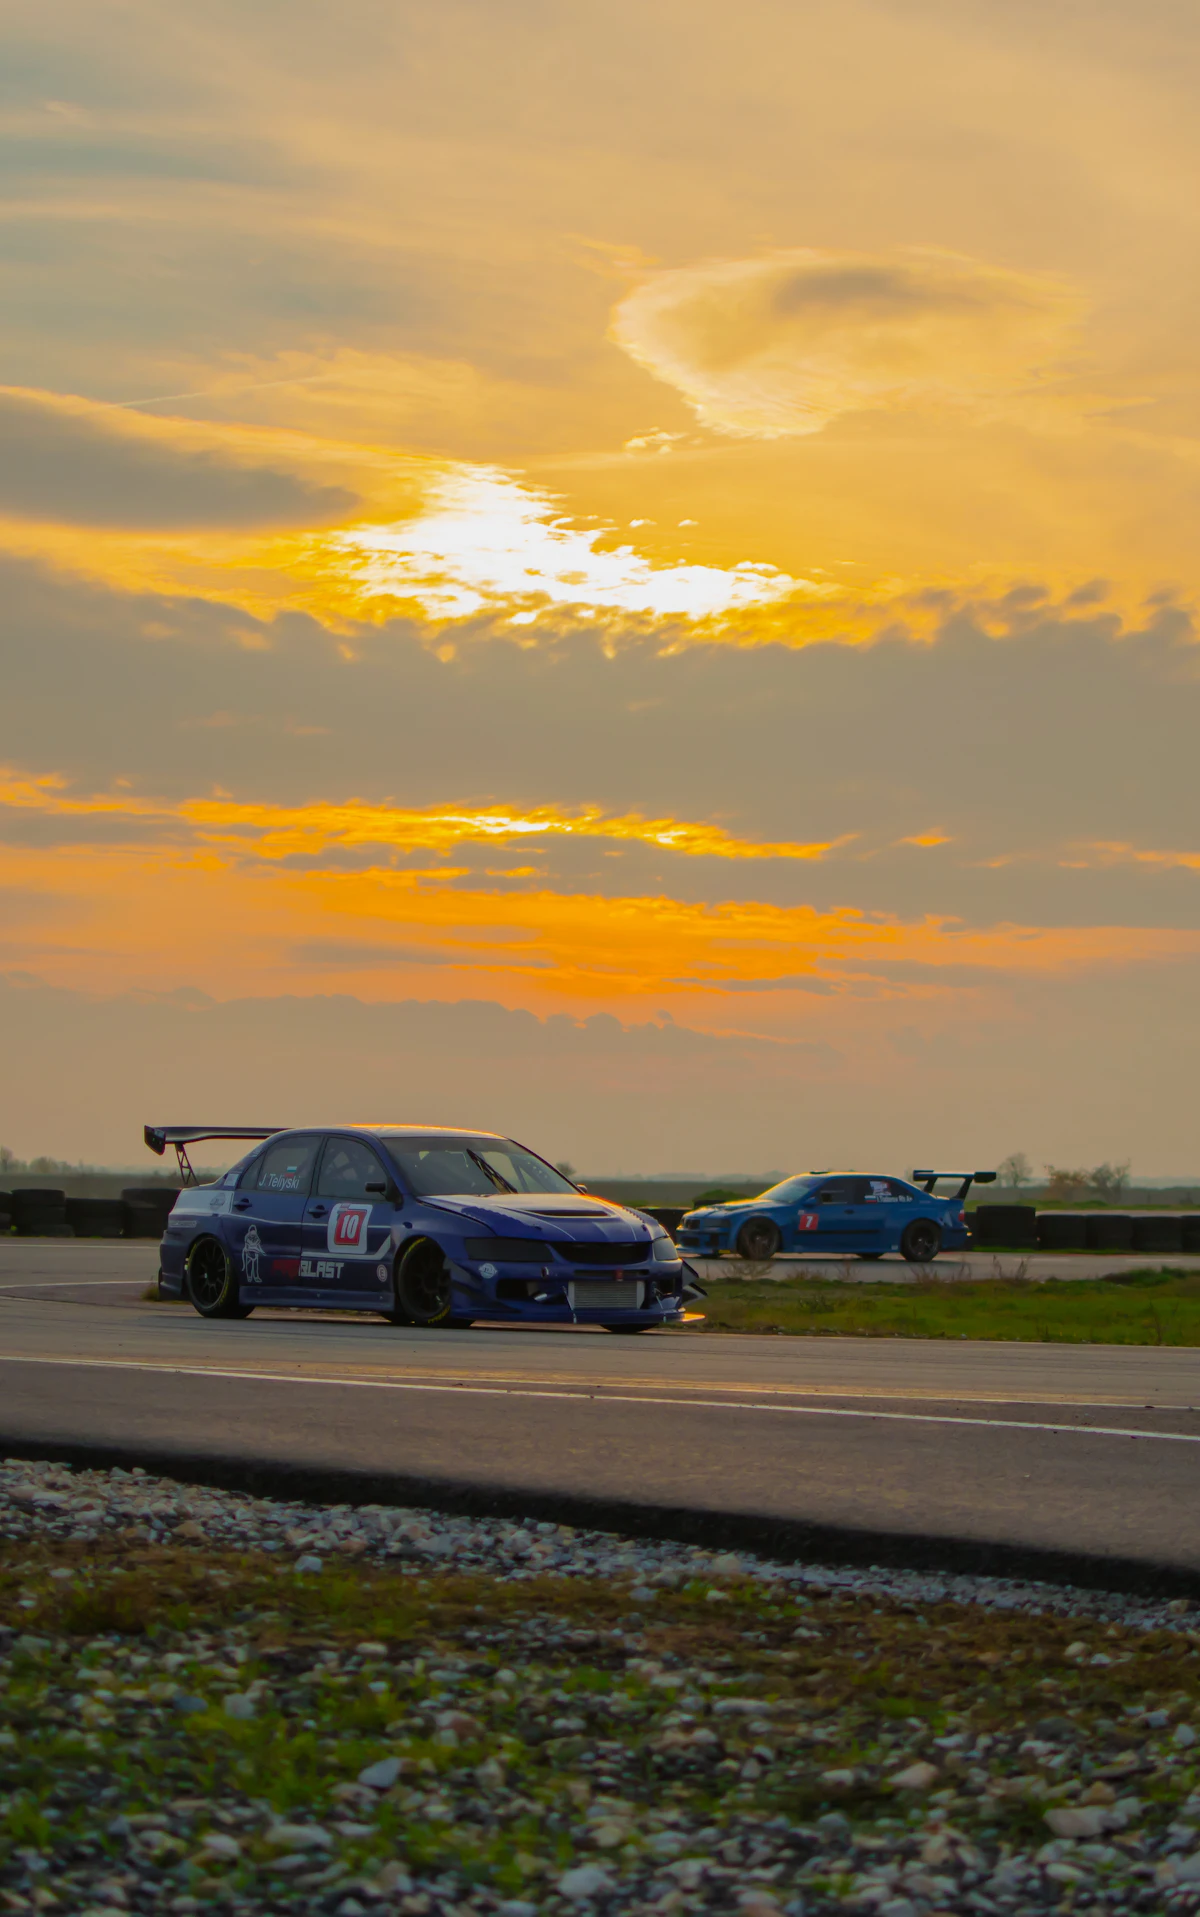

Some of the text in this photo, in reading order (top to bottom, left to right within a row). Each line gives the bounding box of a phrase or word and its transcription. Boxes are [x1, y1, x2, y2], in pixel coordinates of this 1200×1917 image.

[268, 1173, 301, 1191] Teliyski
[340, 1214, 360, 1239] 10
[806, 1216, 813, 1228] 7
